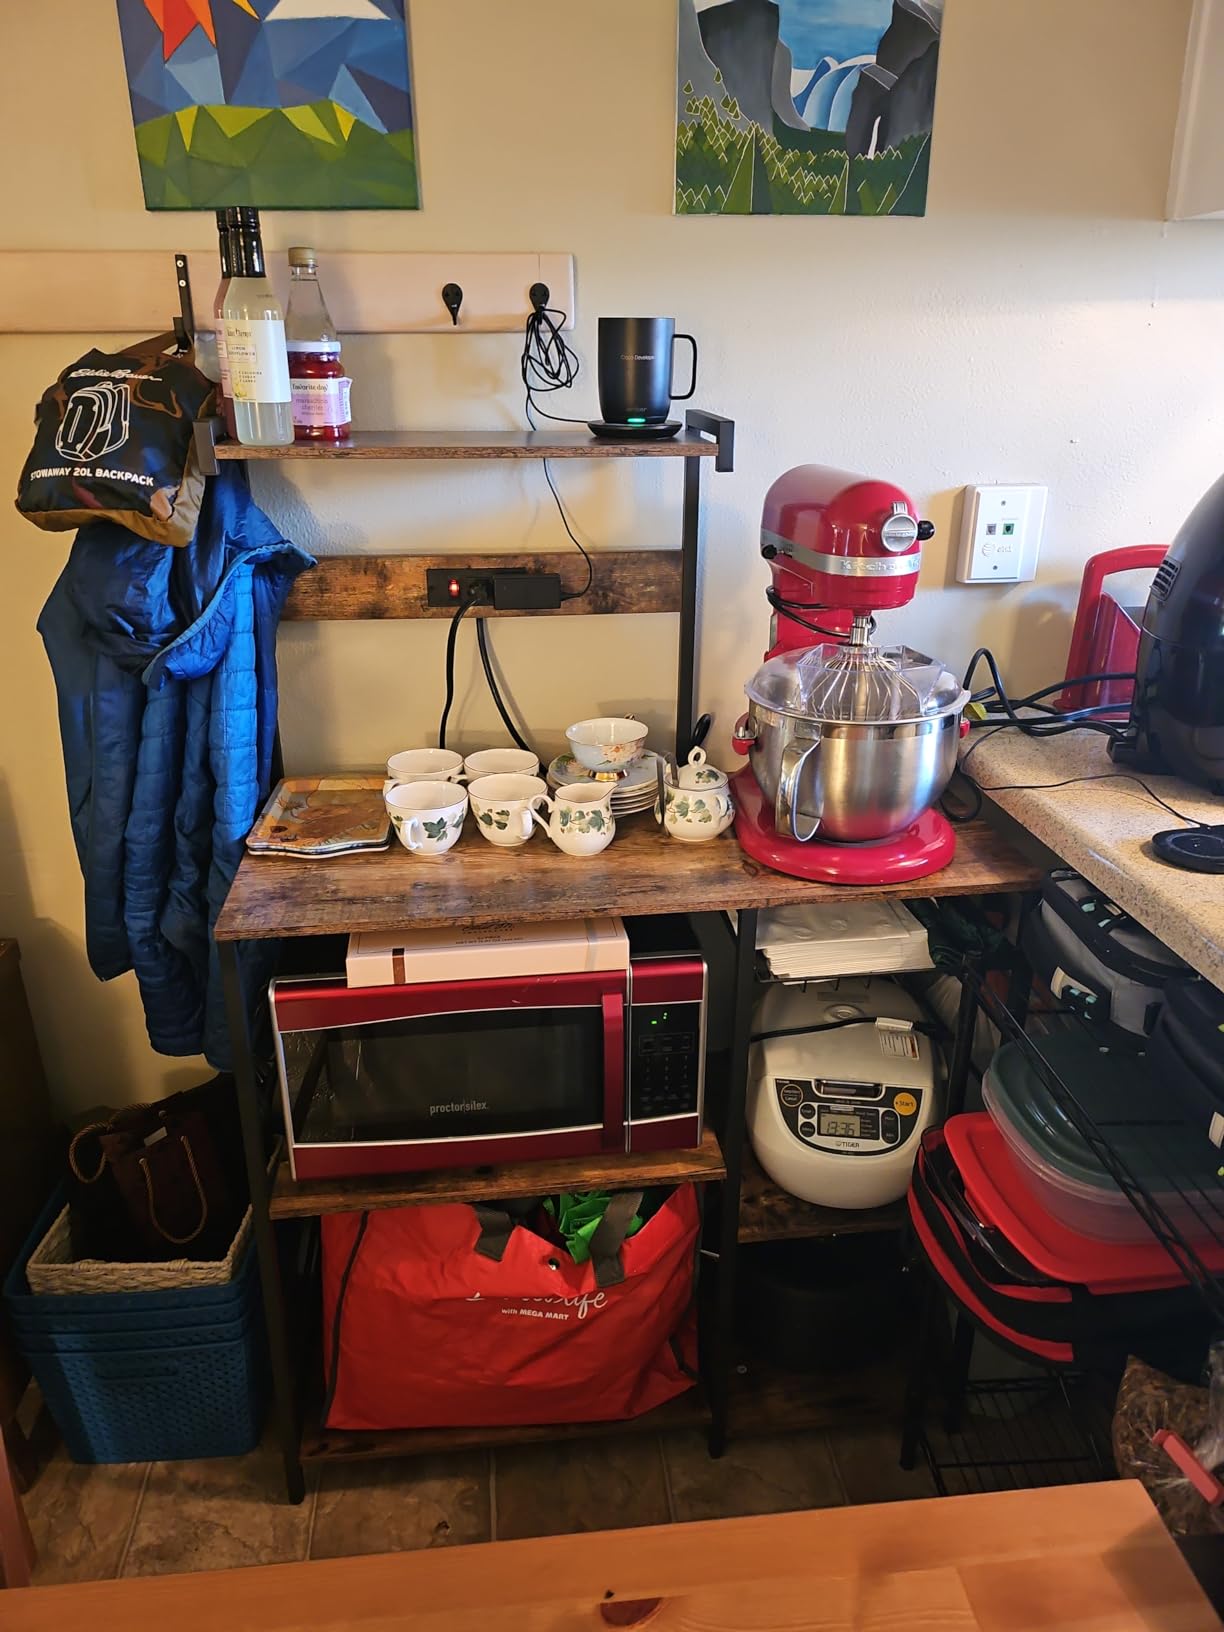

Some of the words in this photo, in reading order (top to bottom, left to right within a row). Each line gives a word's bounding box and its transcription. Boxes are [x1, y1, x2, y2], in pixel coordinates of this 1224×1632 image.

[30, 467, 71, 481] STOWAWAY
[72, 467, 93, 477] 20L
[95, 468, 154, 487] BACKPACK
[519, 1308, 544, 1318] MEGA
[544, 1311, 570, 1321] MART
